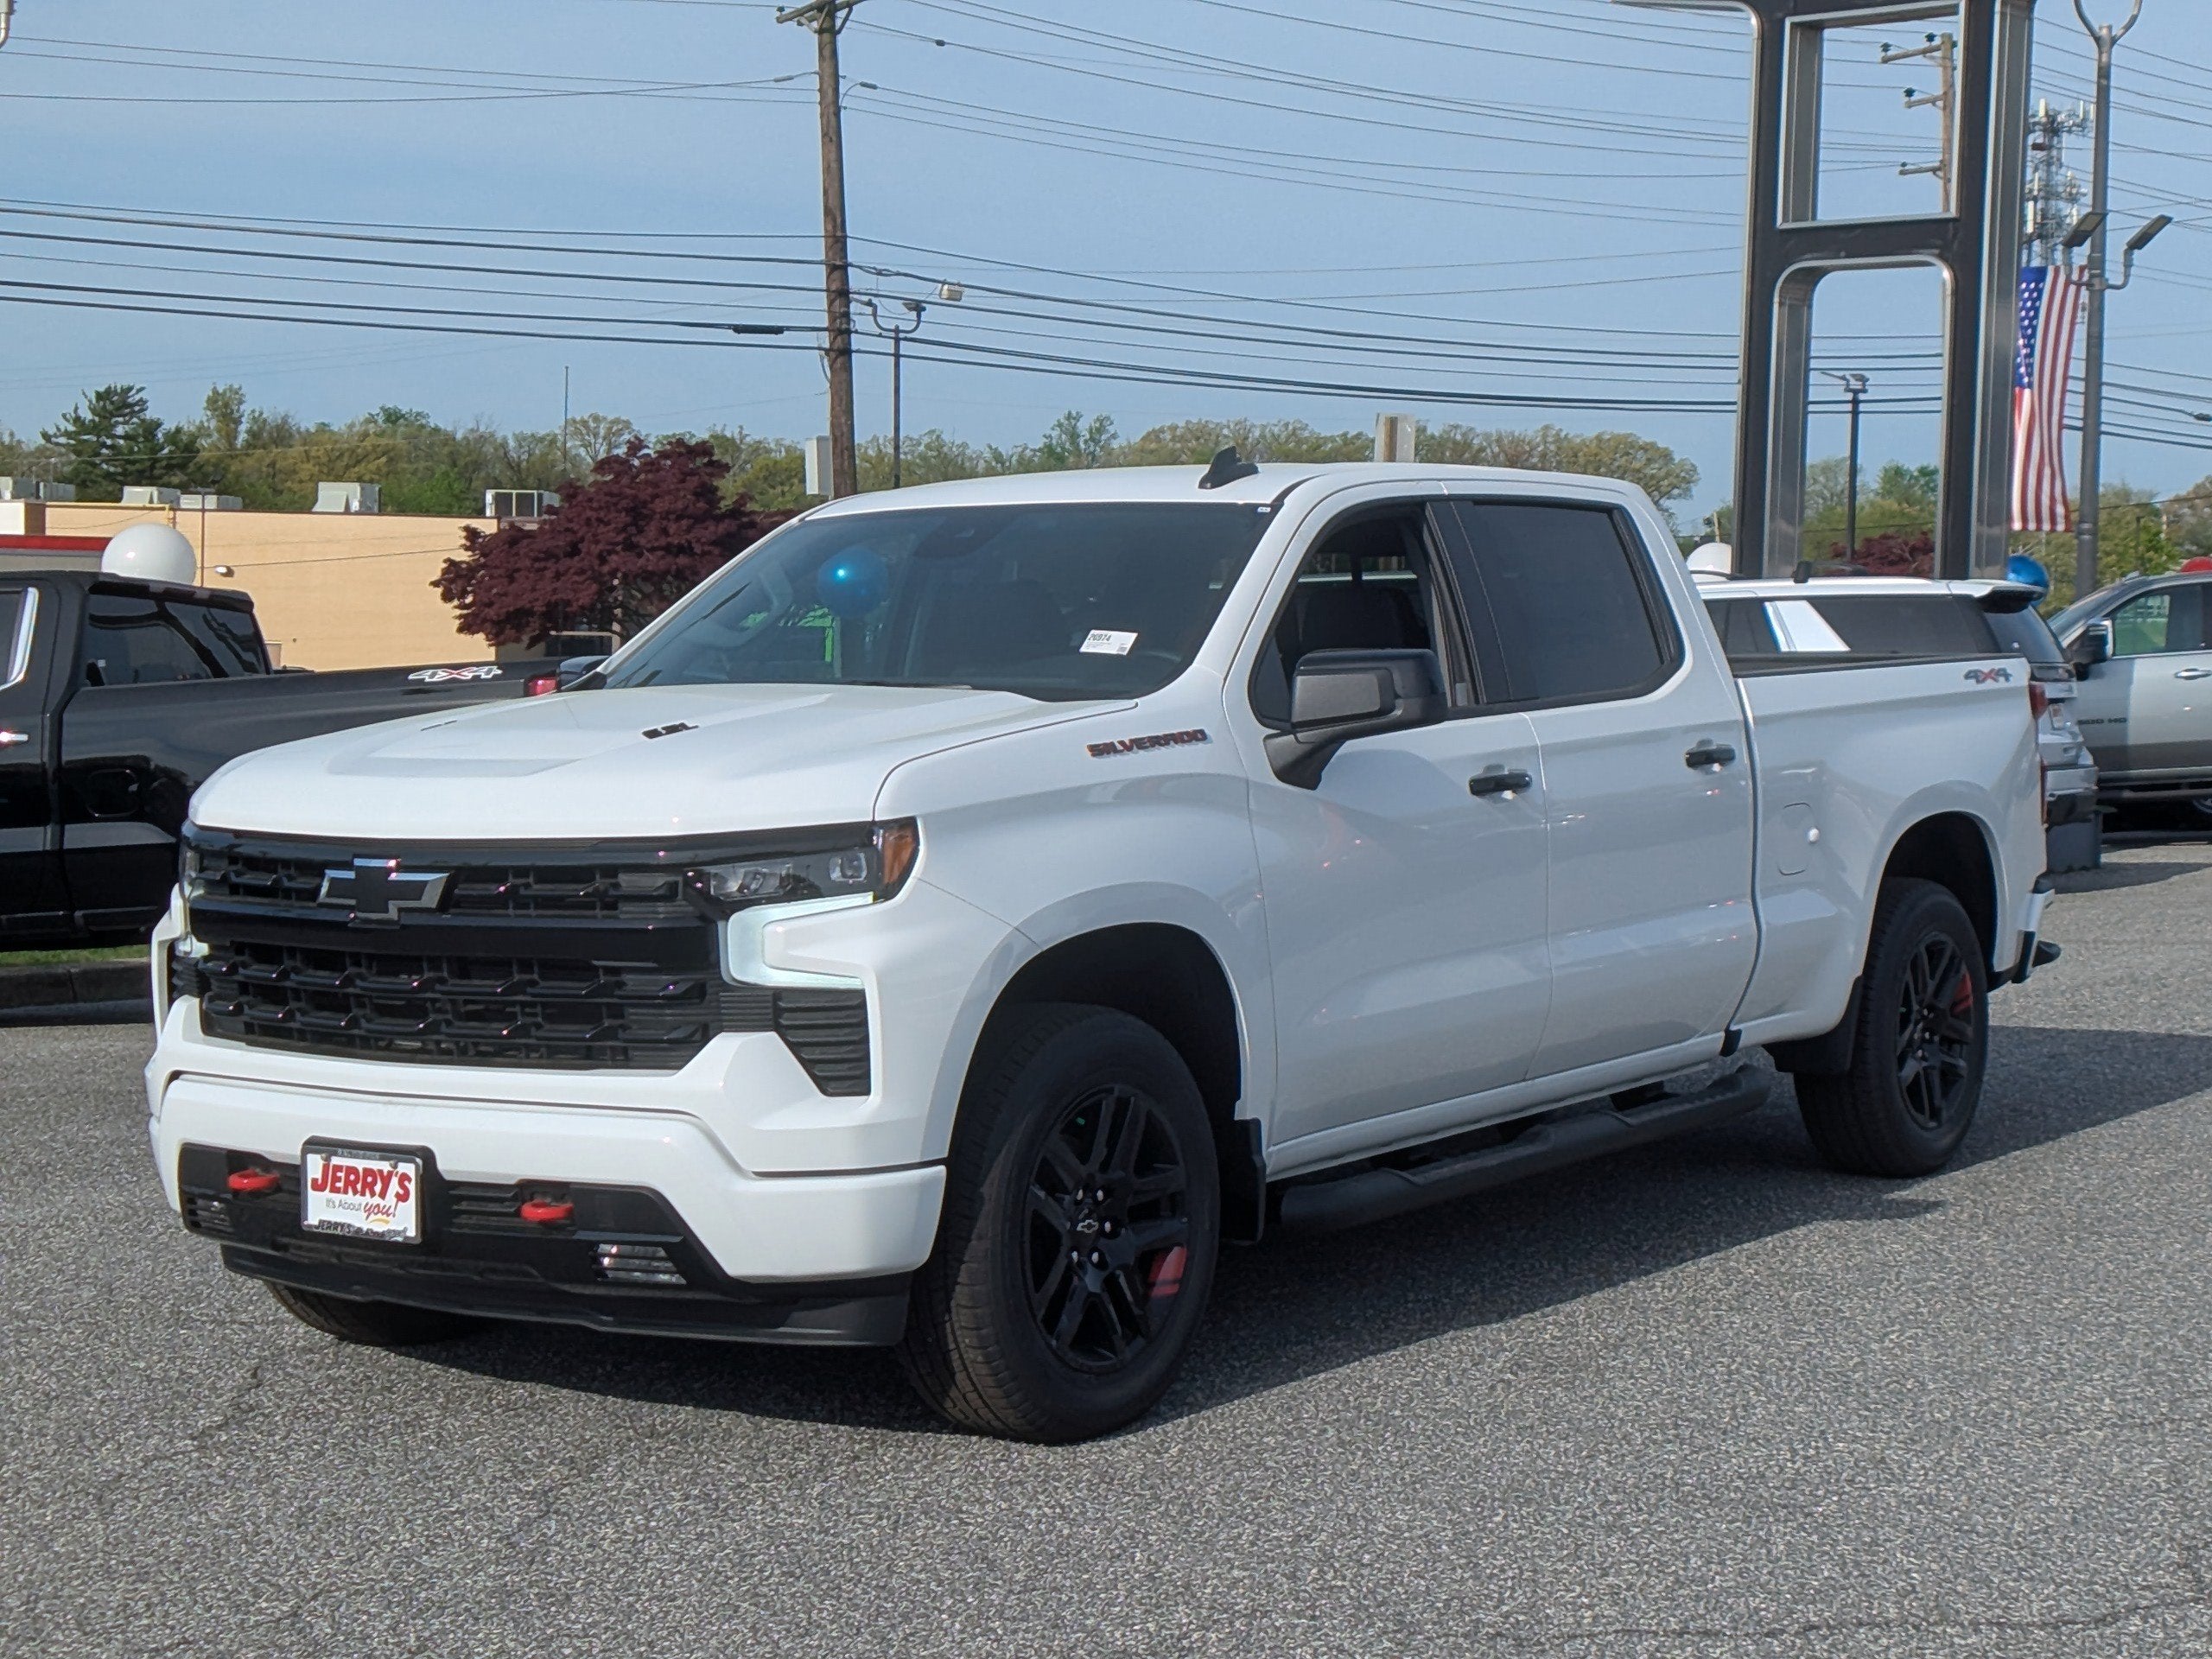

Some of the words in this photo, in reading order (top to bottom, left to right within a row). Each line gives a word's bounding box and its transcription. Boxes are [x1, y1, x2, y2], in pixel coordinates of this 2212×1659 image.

[1087, 728, 1208, 757] SILVERADO
[310, 1161, 412, 1203] JERRY'S
[363, 1198, 400, 1221] you!
